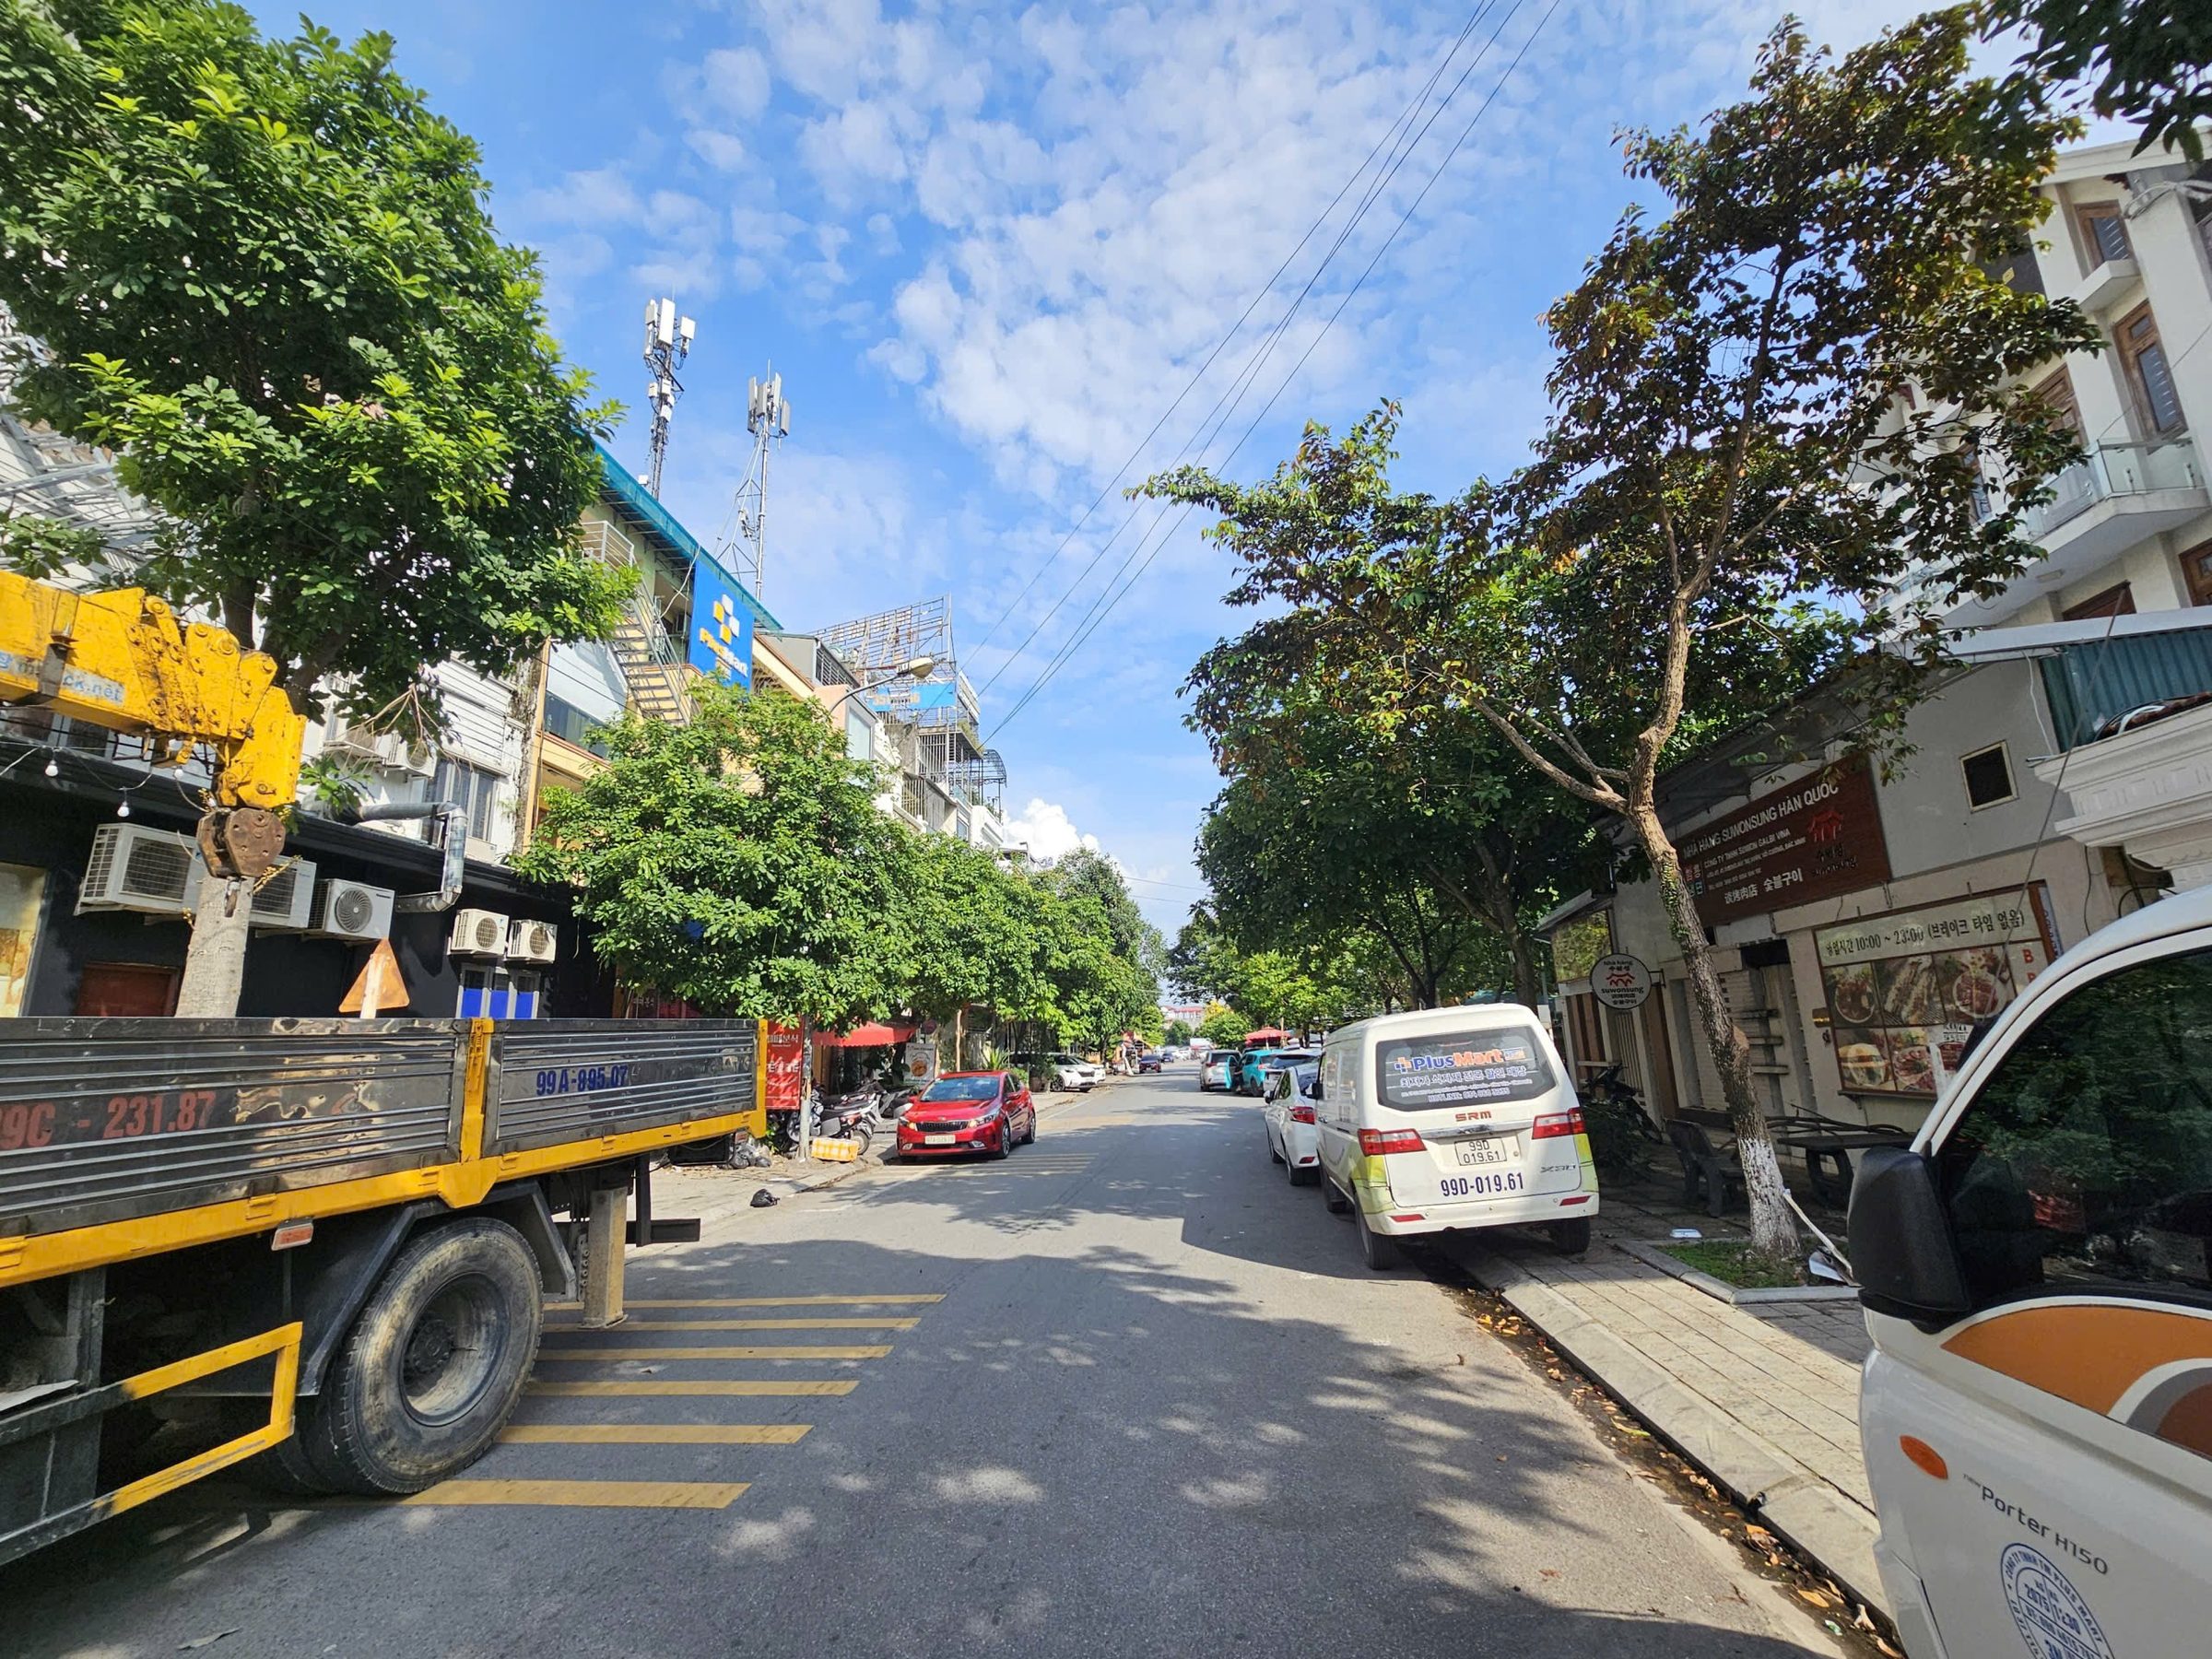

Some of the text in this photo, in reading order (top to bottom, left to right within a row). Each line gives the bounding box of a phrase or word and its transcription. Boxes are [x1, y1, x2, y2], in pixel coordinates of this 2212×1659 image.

[1699, 832, 1722, 853] HÀNG
[1722, 806, 1777, 842] SUWONSUNG
[1778, 794, 1803, 818] HÀN
[1763, 867, 1804, 892] 숯불구이
[1855, 933, 1881, 951] 10:00
[1893, 928, 1924, 946] 23:00
[1927, 917, 1970, 939] (브레이크
[1972, 914, 1994, 933] 타임
[1412, 1048, 1505, 1071] PlusMart
[103, 1090, 218, 1139] 231.87
[1454, 1111, 1492, 1123] SRM
[1463, 1150, 1500, 1164] 019.61
[1469, 1140, 1489, 1151] 99D
[1441, 1172, 1524, 1196] 99D-019.61
[1982, 1486, 2050, 1537] Porter
[2055, 1533, 2108, 1575] H150
[2053, 1571, 2077, 1604] PLUS
[2077, 1605, 2102, 1643] MART
